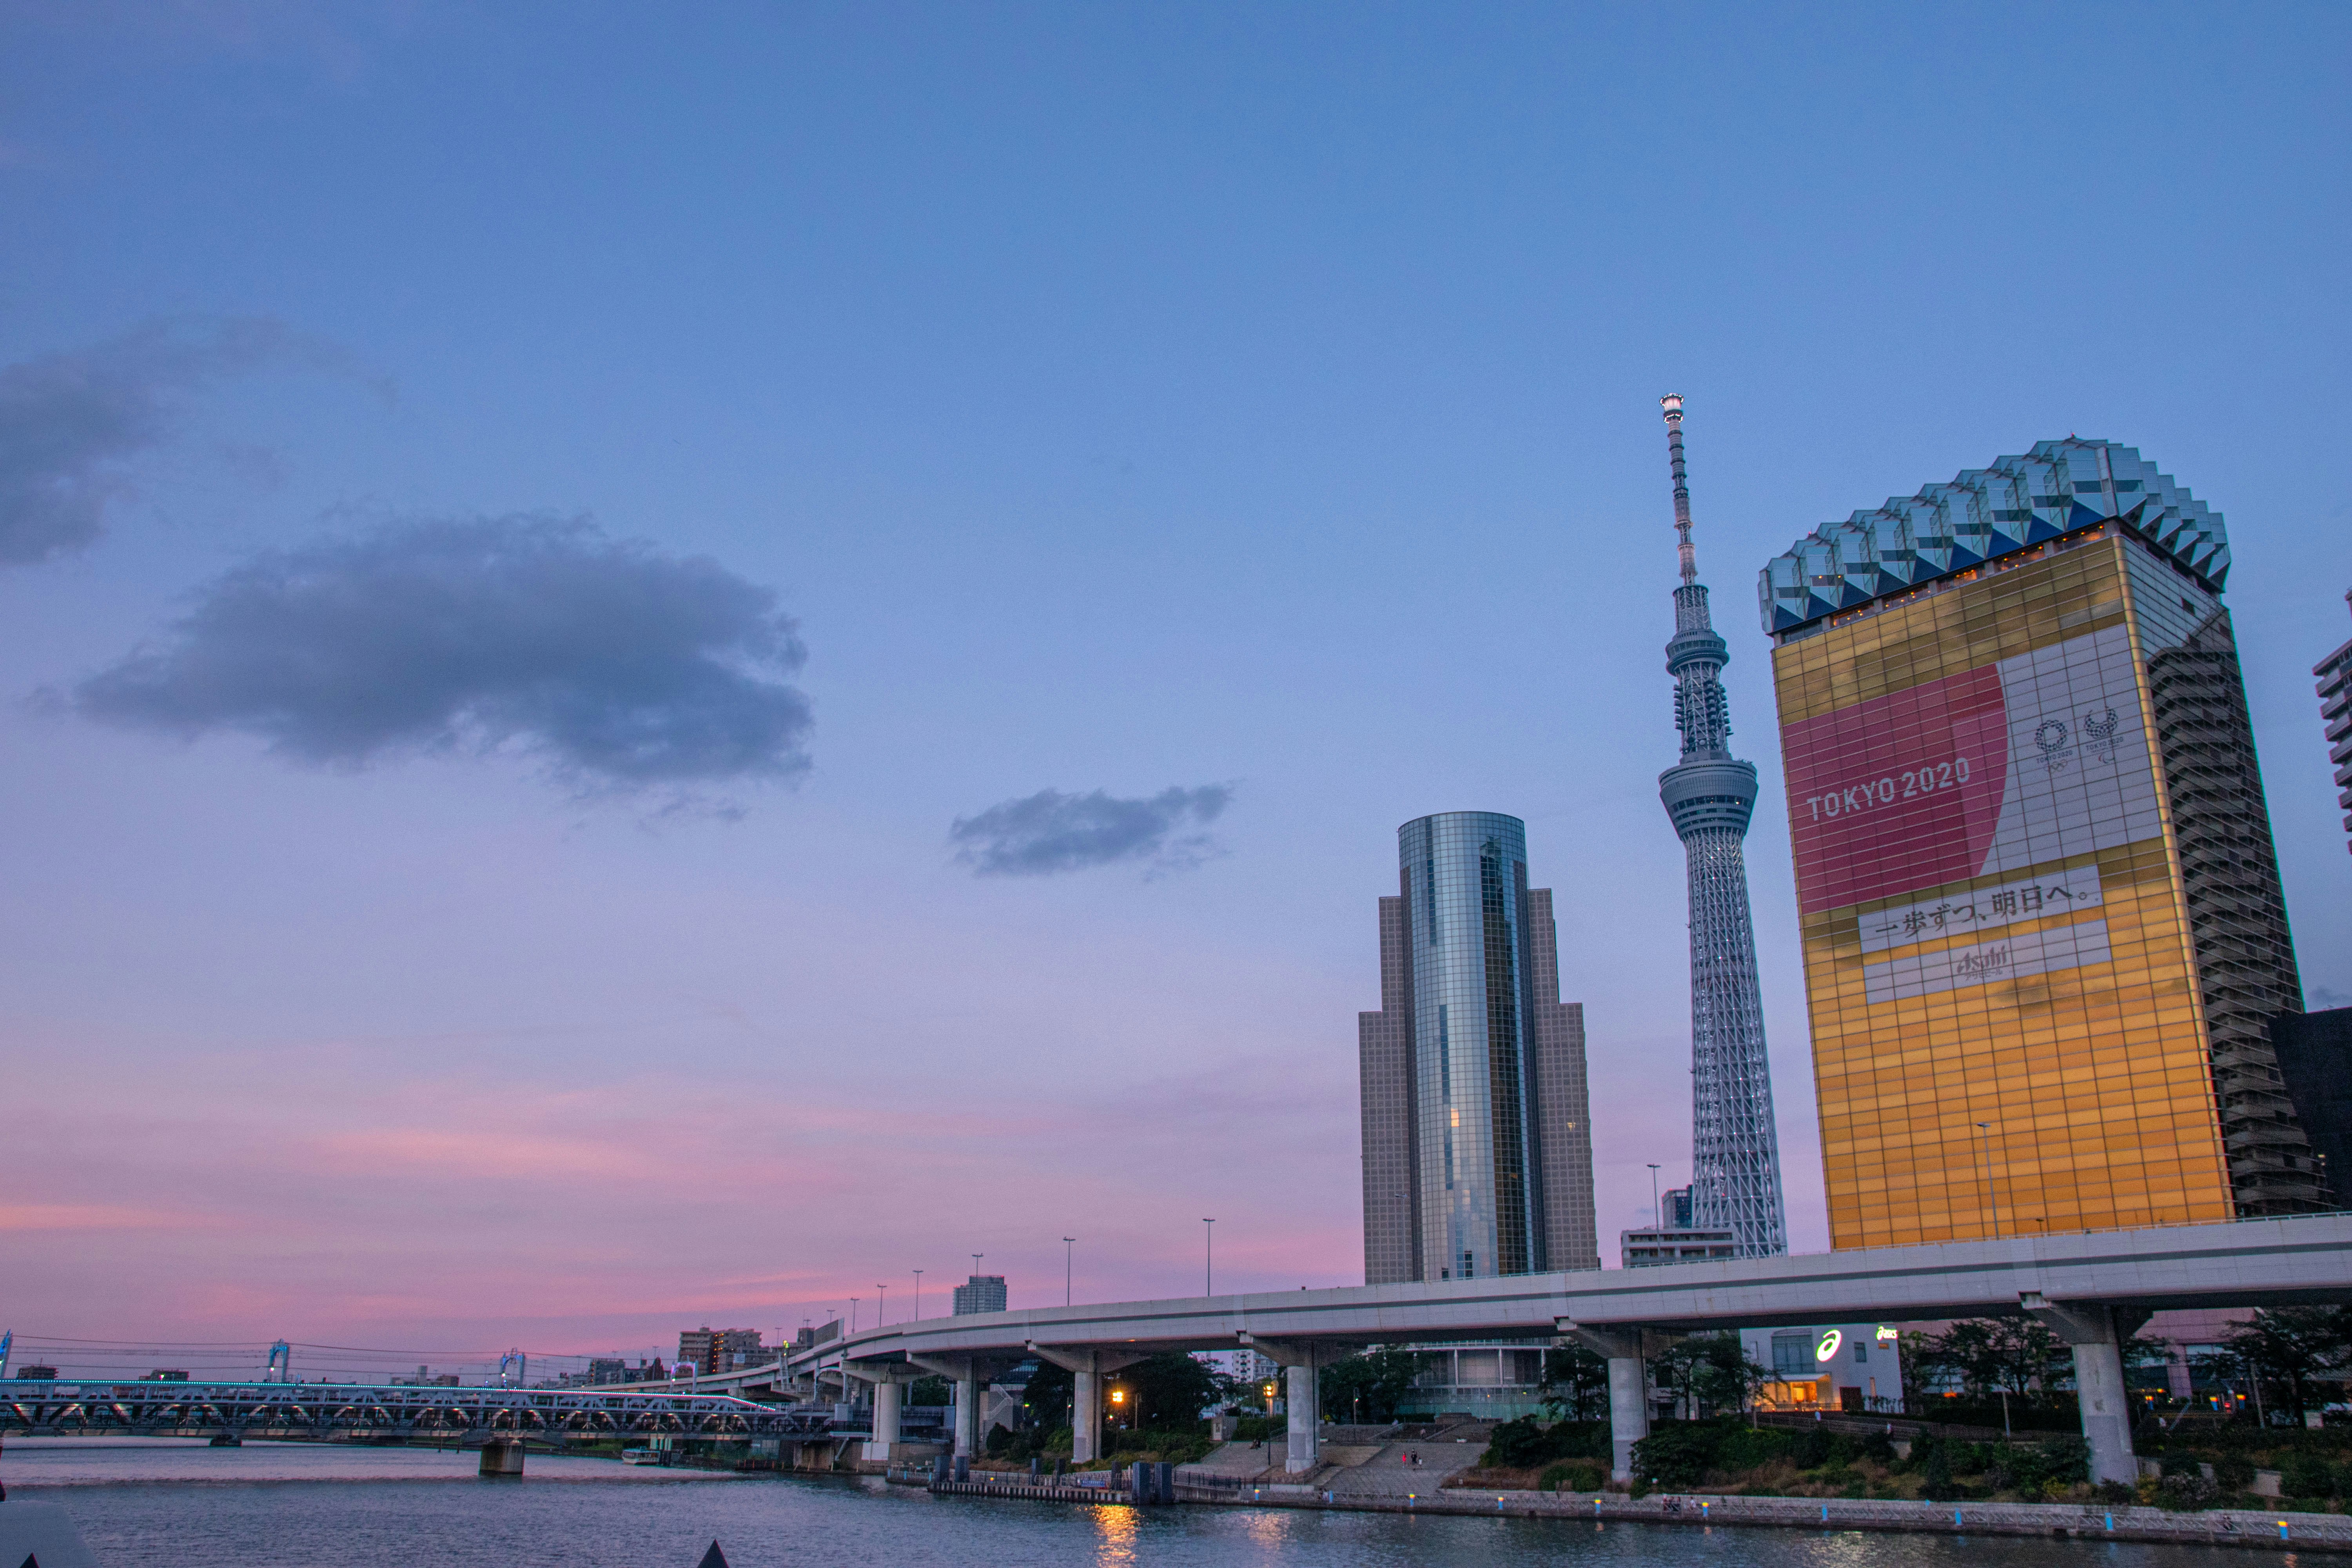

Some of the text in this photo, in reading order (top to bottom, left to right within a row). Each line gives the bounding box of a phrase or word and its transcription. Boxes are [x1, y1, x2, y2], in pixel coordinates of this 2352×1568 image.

[2037, 750, 2073, 764] TOKYO 2020
[2086, 741, 2107, 751] TOKYO
[2108, 737, 2124, 746] 2020
[1806, 757, 1970, 821] TOKYO 2020
[1875, 886, 2087, 938] 一歩ずつ、明日へ。
[1957, 944, 2006, 974] Asahi
